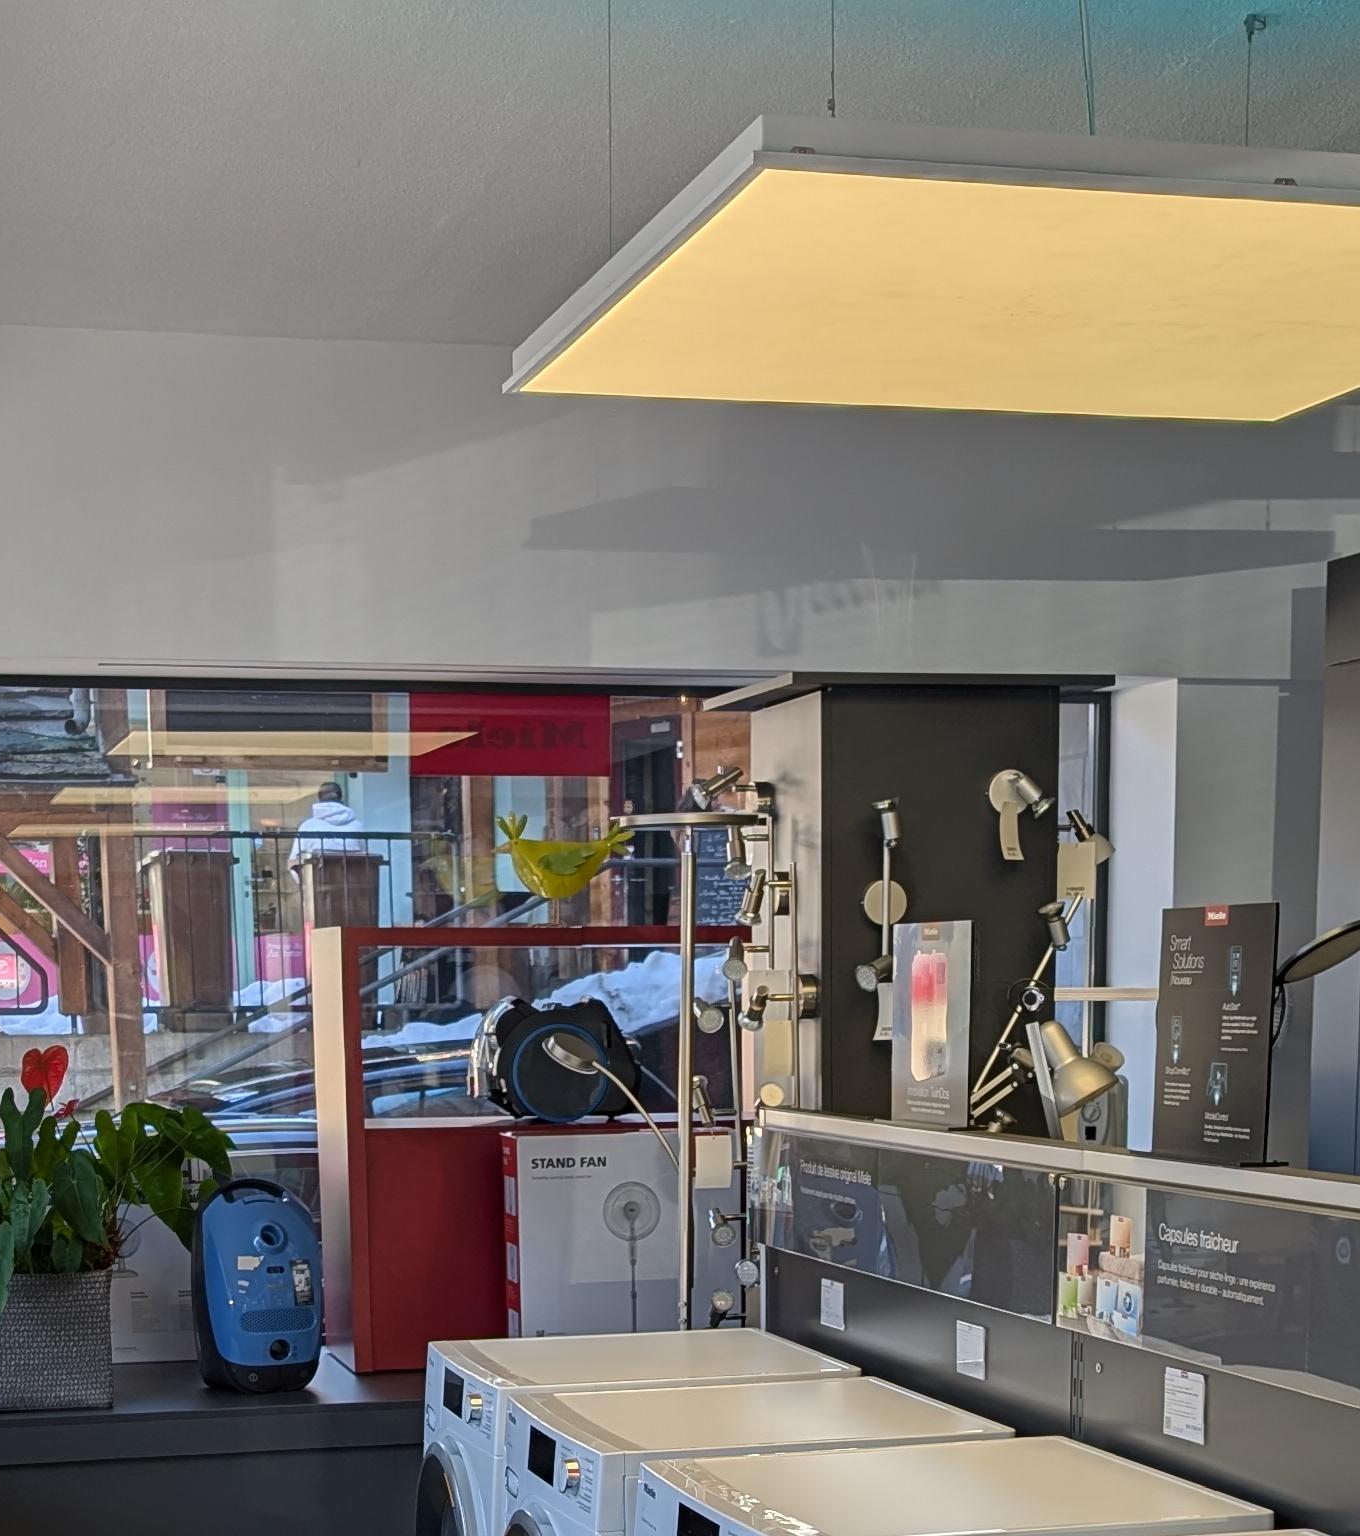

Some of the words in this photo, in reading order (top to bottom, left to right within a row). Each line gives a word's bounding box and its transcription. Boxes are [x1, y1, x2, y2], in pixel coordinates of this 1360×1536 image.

[1170, 934, 1192, 952] Smart
[1172, 953, 1205, 969] Solutions
[531, 1157, 576, 1169] STAND
[580, 1156, 607, 1168] FAN
[1159, 1223, 1199, 1247] Capsules
